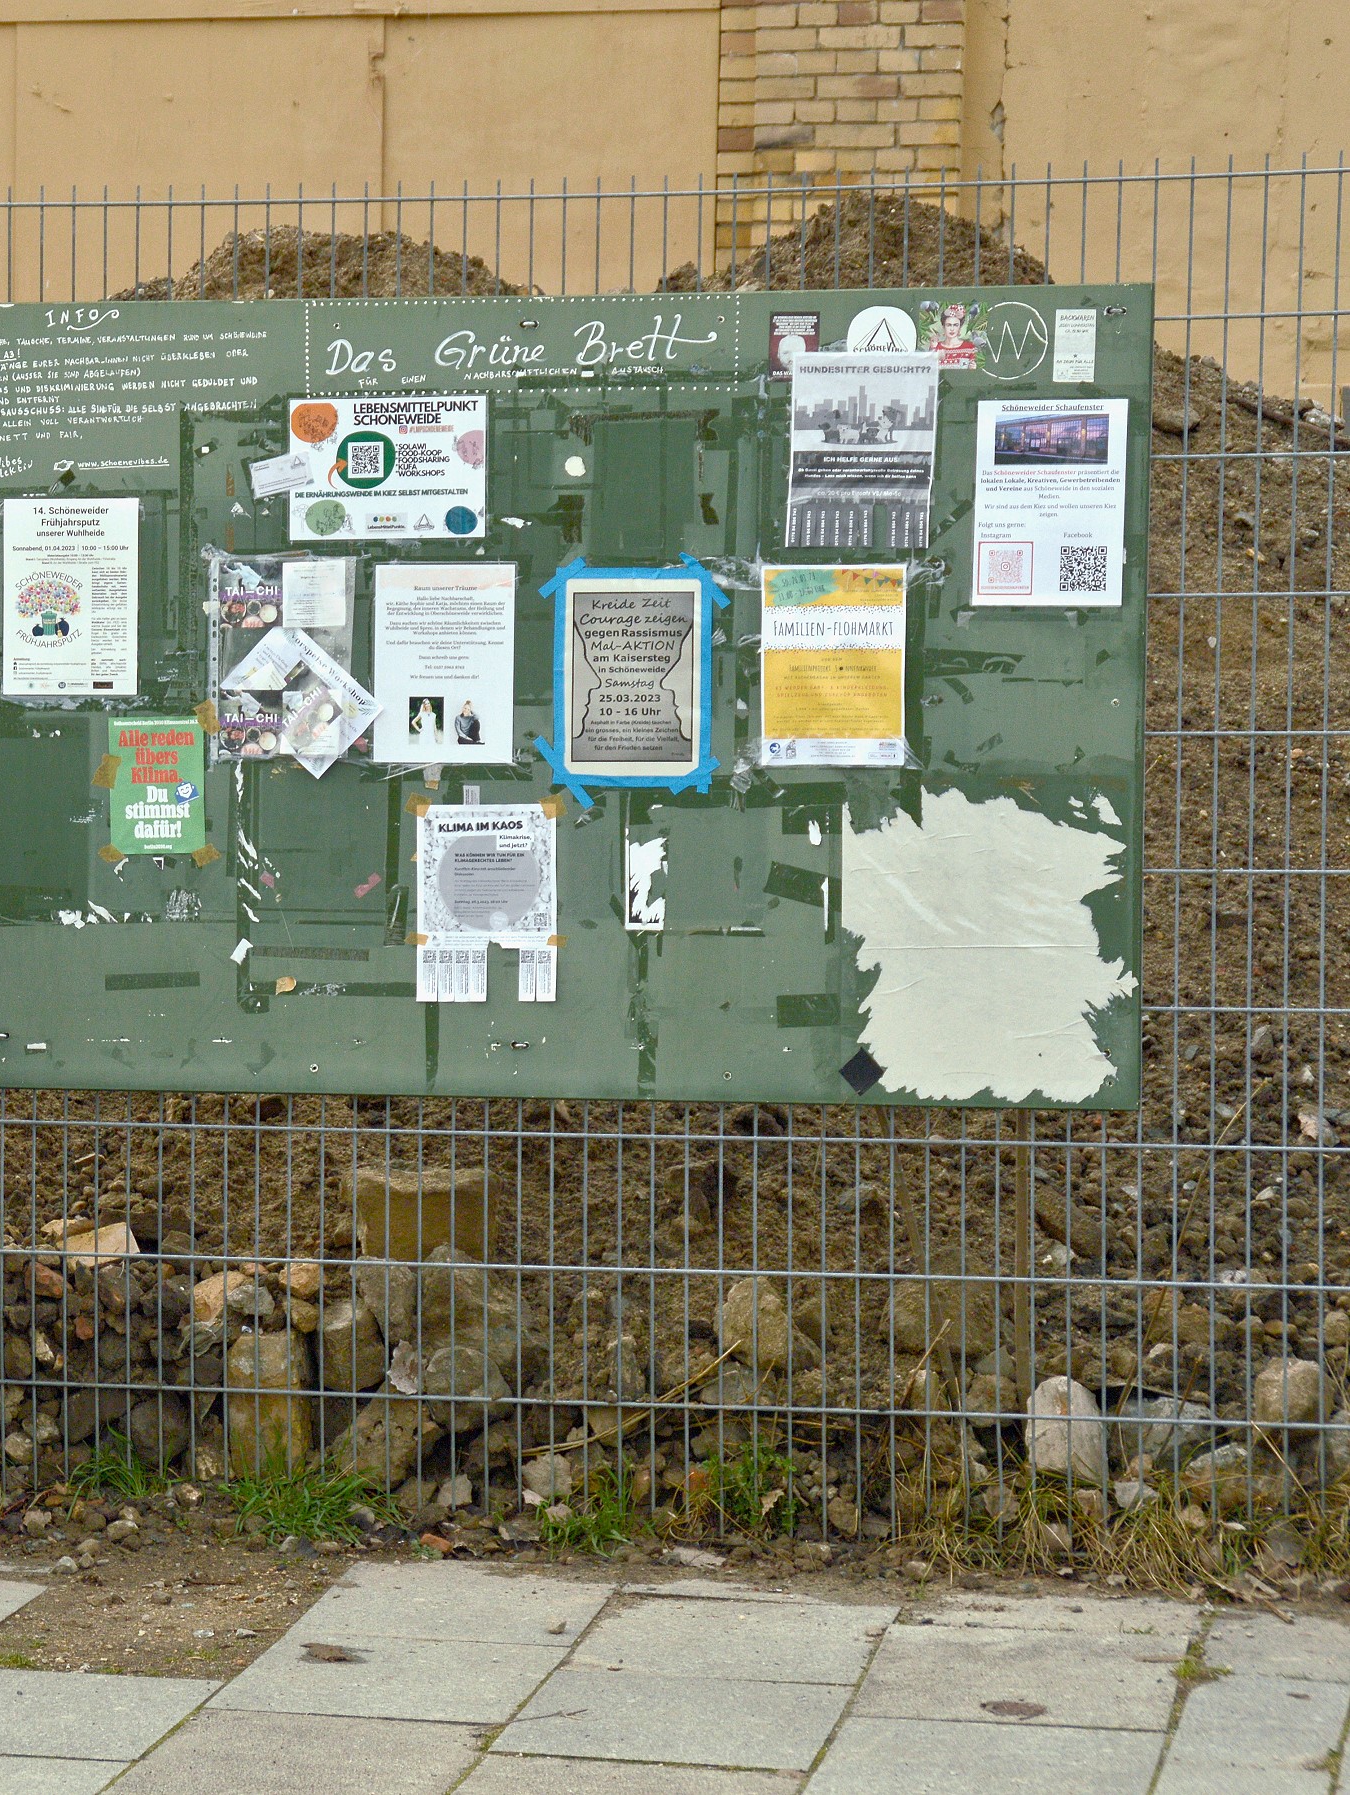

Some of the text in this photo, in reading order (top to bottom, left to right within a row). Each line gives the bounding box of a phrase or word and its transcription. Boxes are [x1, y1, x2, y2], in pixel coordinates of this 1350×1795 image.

[45, 309, 105, 328] INFO
[57, 337, 95, 345] TERMINE,
[97, 334, 175, 343] VERANSTALTUNGEN
[326, 314, 717, 375] Das Grüne Brett
[161, 352, 215, 361] ÜBERKLEBEN
[226, 349, 249, 357] ODER
[12, 372, 42, 381] (AUSSER
[84, 367, 140, 378] ABGELAUFEN)
[800, 366, 870, 374] HUNDESITTER
[873, 366, 931, 374] GESUCHT??
[358, 366, 663, 389] FÜR EINEN NACHBARSCHAFTLICHEN AUSTAUSCH
[16, 385, 31, 393] UND
[36, 383, 114, 392] DISKRIMINIERUNG
[122, 381, 155, 390] WERDEN
[161, 380, 186, 388] NICHT
[192, 378, 235, 387] GEDULDET
[241, 376, 258, 385] UND
[17, 396, 59, 404] ENTFERNT
[68, 405, 86, 414] ALLE
[126, 405, 138, 413] DIE
[142, 403, 176, 413] SELBST
[184, 399, 256, 411] ANGEBRACHTEN
[354, 401, 478, 414] LEBENSMITTELPUNKT
[3, 419, 31, 427] ALLEIN
[67, 415, 143, 424] VERANTWORTLICH
[0, 433, 28, 442] NETT
[60, 431, 83, 439] FAIR,
[78, 456, 169, 469] www.schoenevibes.de
[306, 490, 373, 498] ERNÄHRUNGSWENDE
[33, 506, 109, 515] 14. Schöneweider
[41, 518, 100, 527] Frühjahrsputz
[15, 570, 83, 591] SCHÖNEWEIDER
[592, 598, 671, 609] Kreide Zeit
[580, 613, 687, 627] Courage zeigen
[16, 629, 82, 648] FRÜHJAHRSPUTZ
[585, 628, 682, 638] gegen Rassismus
[591, 641, 675, 650] Mal-AKTION
[613, 654, 671, 663] Kaisersteg
[292, 631, 366, 705] Vorspeise Workshop
[605, 679, 655, 689] Samstag
[119, 729, 195, 747] Alle reden
[135, 748, 179, 765] übers
[131, 767, 183, 784] Klima.
[147, 786, 168, 802] Du
[125, 801, 190, 819] stimmst
[134, 820, 182, 838] dafür!
[438, 821, 523, 832] KLIMA IM KAOS
